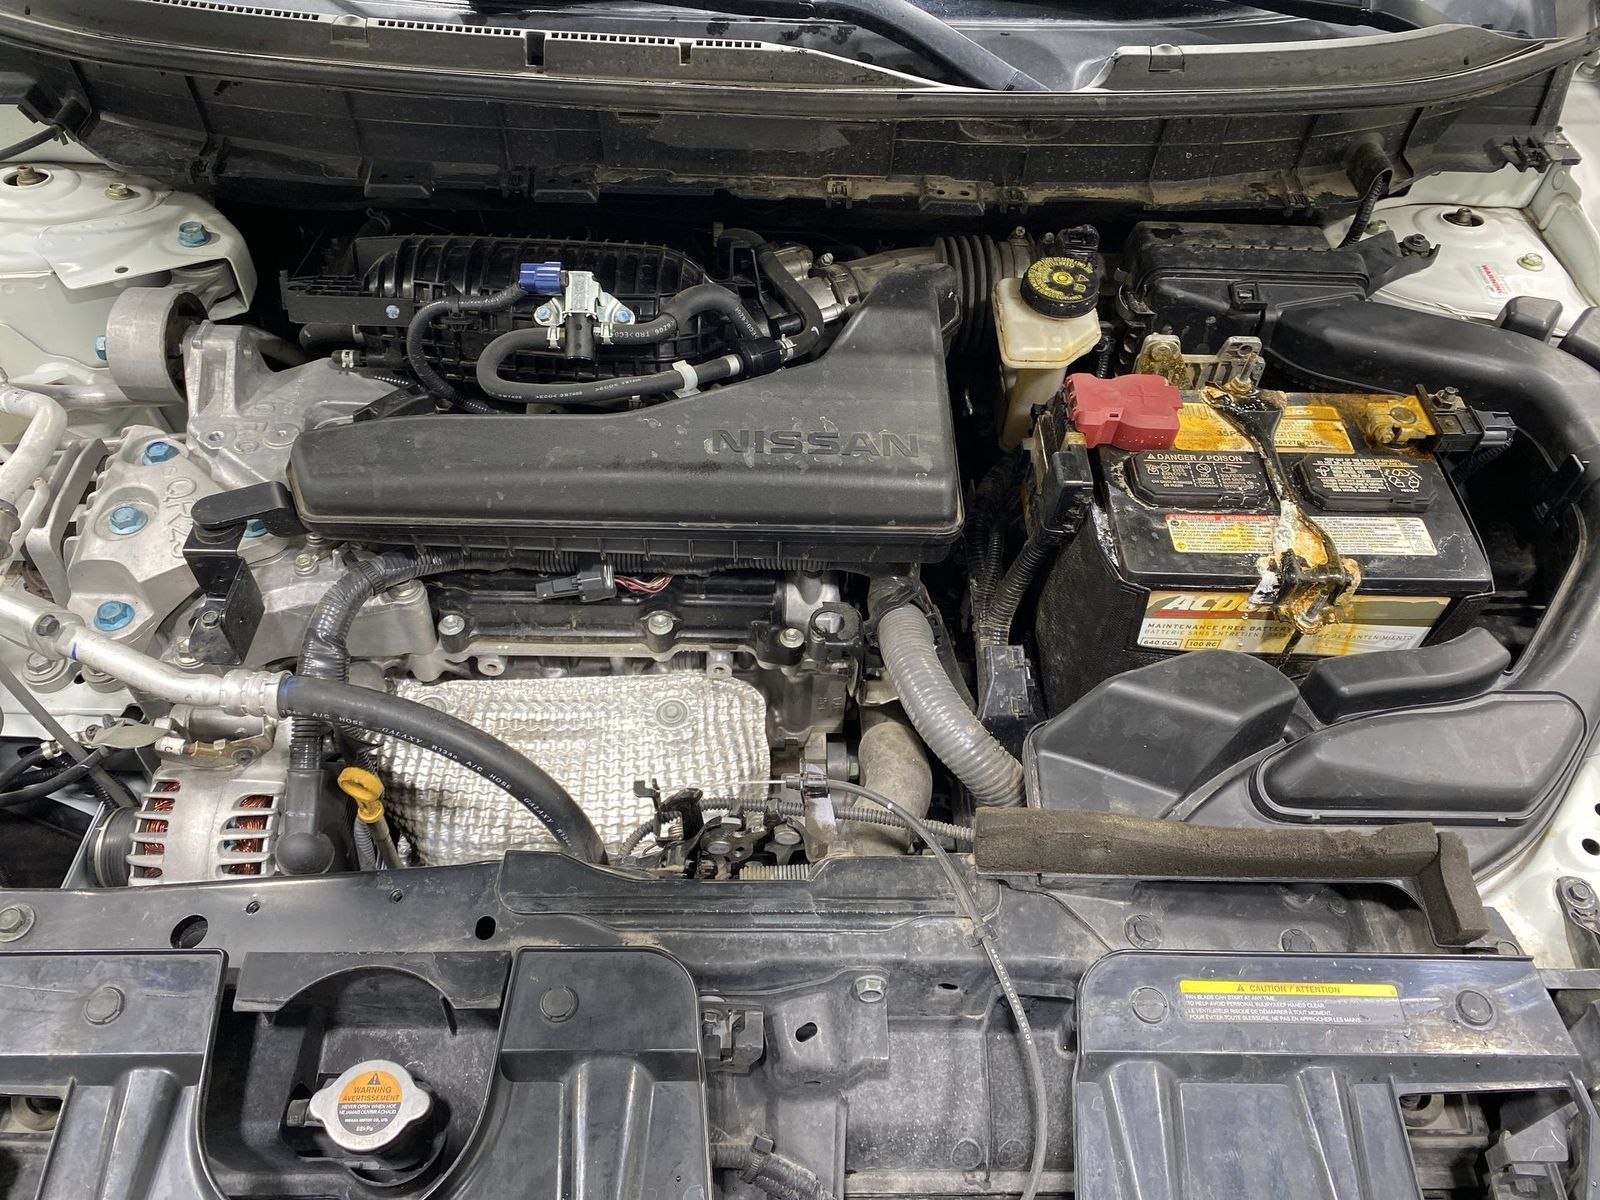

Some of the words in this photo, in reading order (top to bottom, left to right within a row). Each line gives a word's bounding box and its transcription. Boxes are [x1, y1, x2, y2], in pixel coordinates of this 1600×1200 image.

[711, 428, 920, 458] NISSAN
[382, 727, 423, 744] GALAXY
[466, 760, 484, 772] A/C
[489, 774, 512, 790] HOSE
[523, 797, 554, 824] GALAXY
[1296, 986, 1341, 994] ATTENTION
